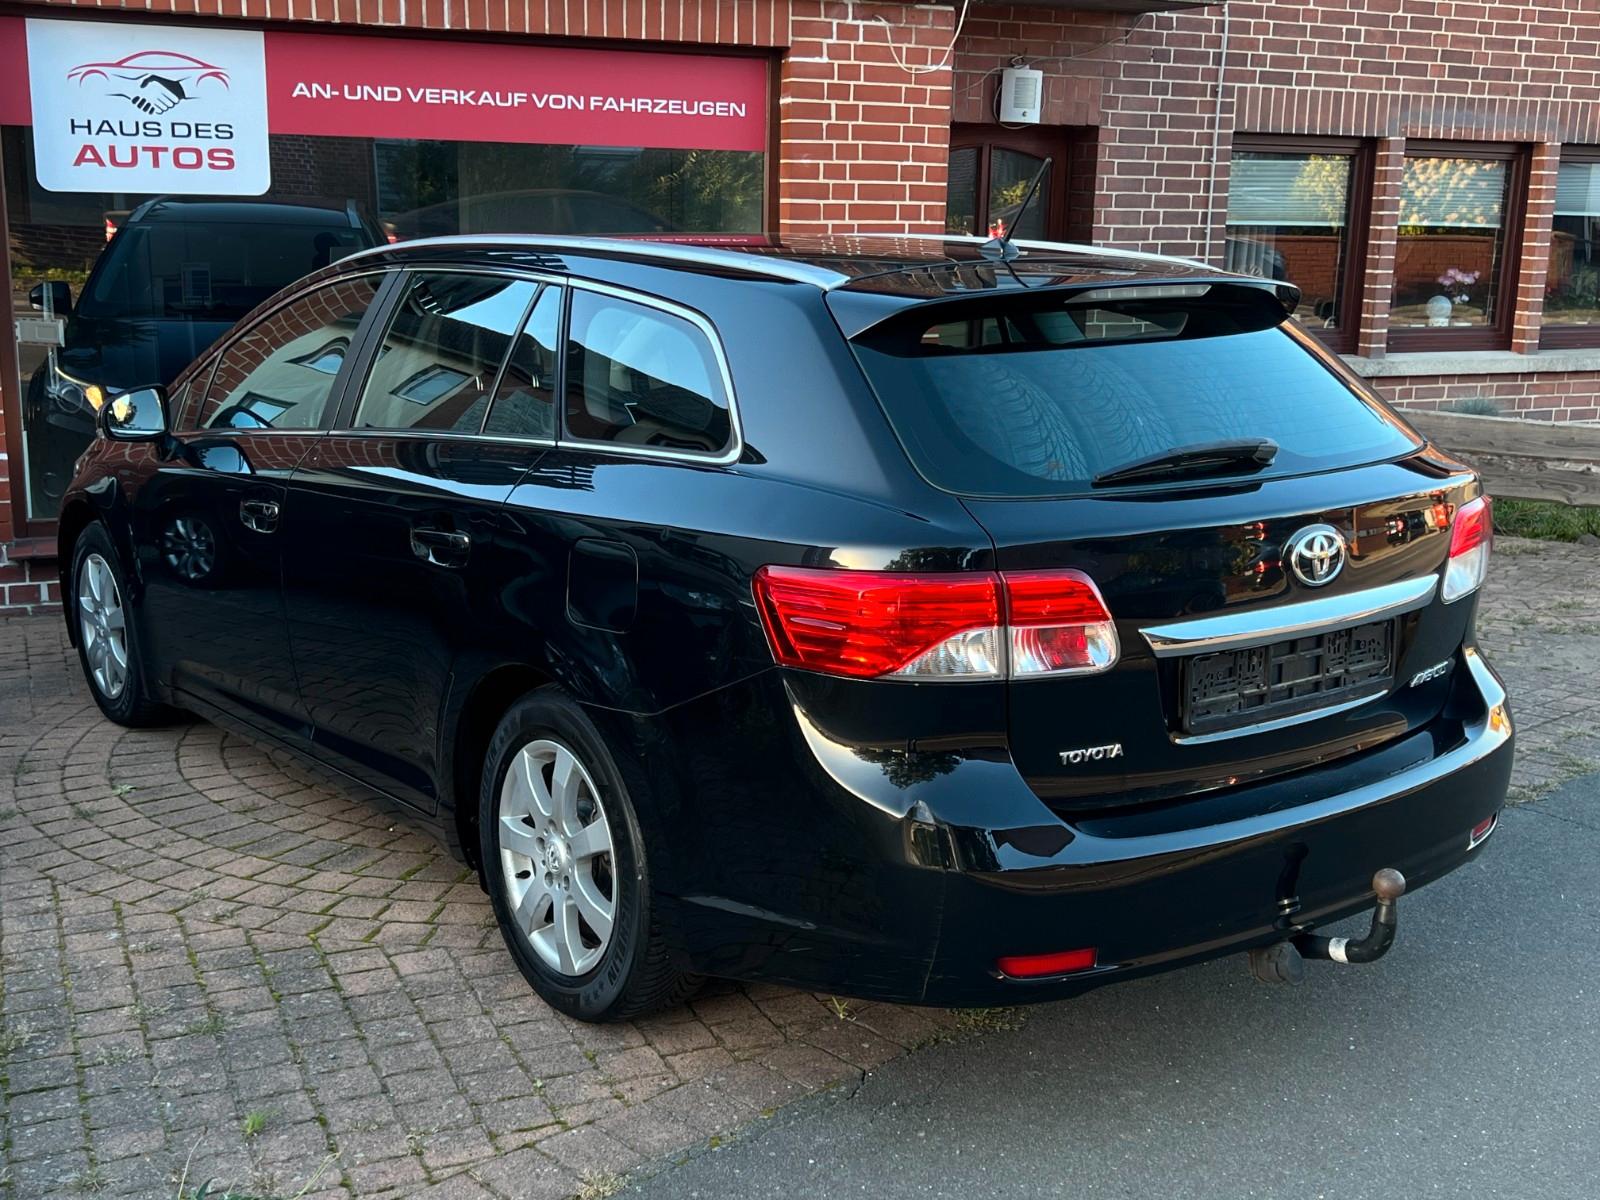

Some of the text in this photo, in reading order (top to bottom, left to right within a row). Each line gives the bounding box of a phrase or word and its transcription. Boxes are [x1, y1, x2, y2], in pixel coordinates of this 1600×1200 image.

[291, 82, 746, 117] AN- UND VERKAUF VON FAHRZEUGEN
[70, 118, 234, 140] HAUS DES
[72, 144, 236, 171] AUTOS
[1059, 743, 1124, 766] TOYOTA
